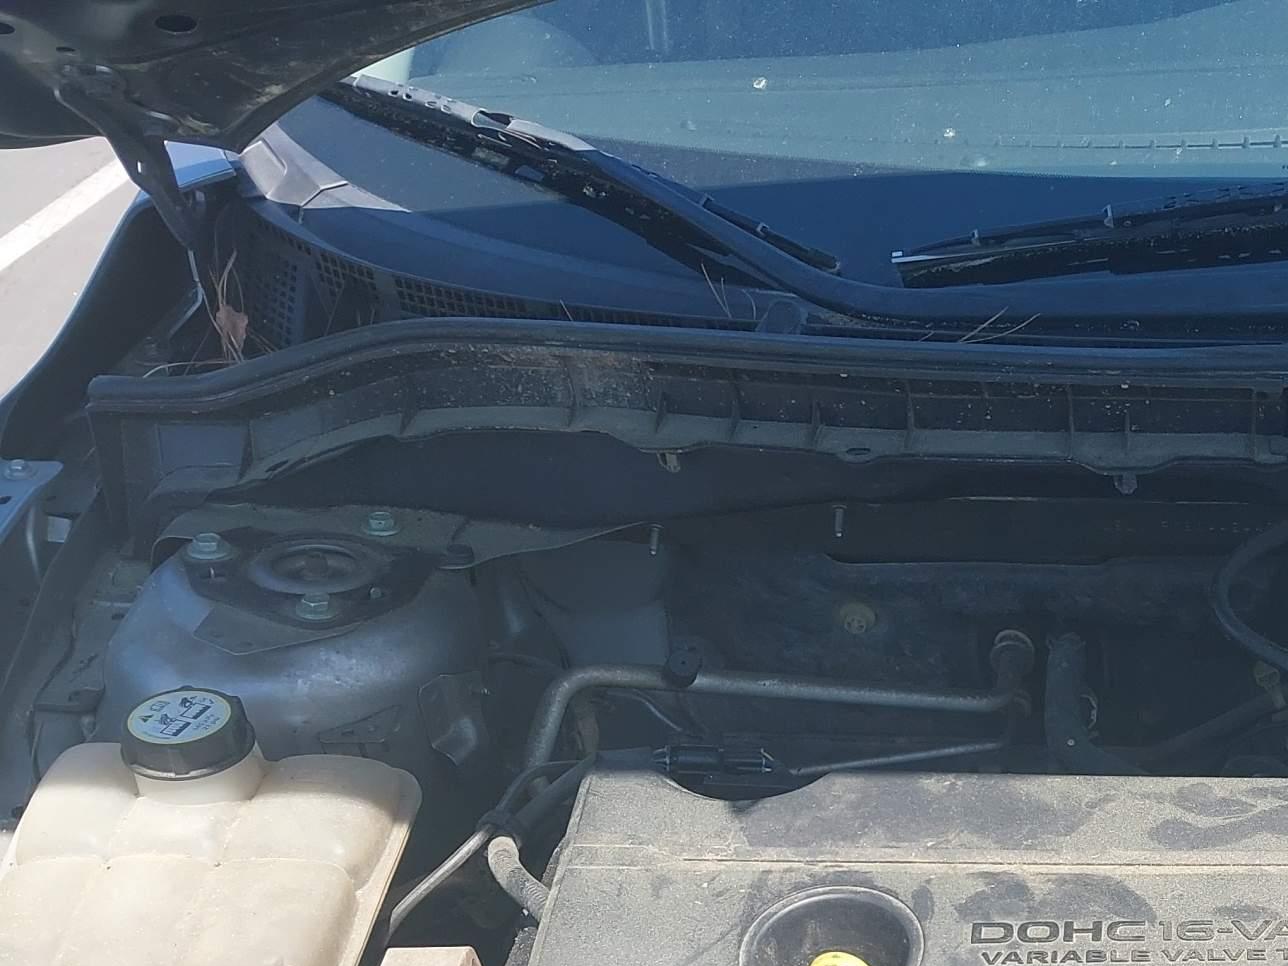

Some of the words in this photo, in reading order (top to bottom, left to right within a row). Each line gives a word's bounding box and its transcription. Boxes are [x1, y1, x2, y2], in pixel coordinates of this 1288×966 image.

[971, 920, 1146, 944] DOHC
[981, 950, 1150, 966] VARIABLE
[1162, 949, 1267, 962] VALVE
